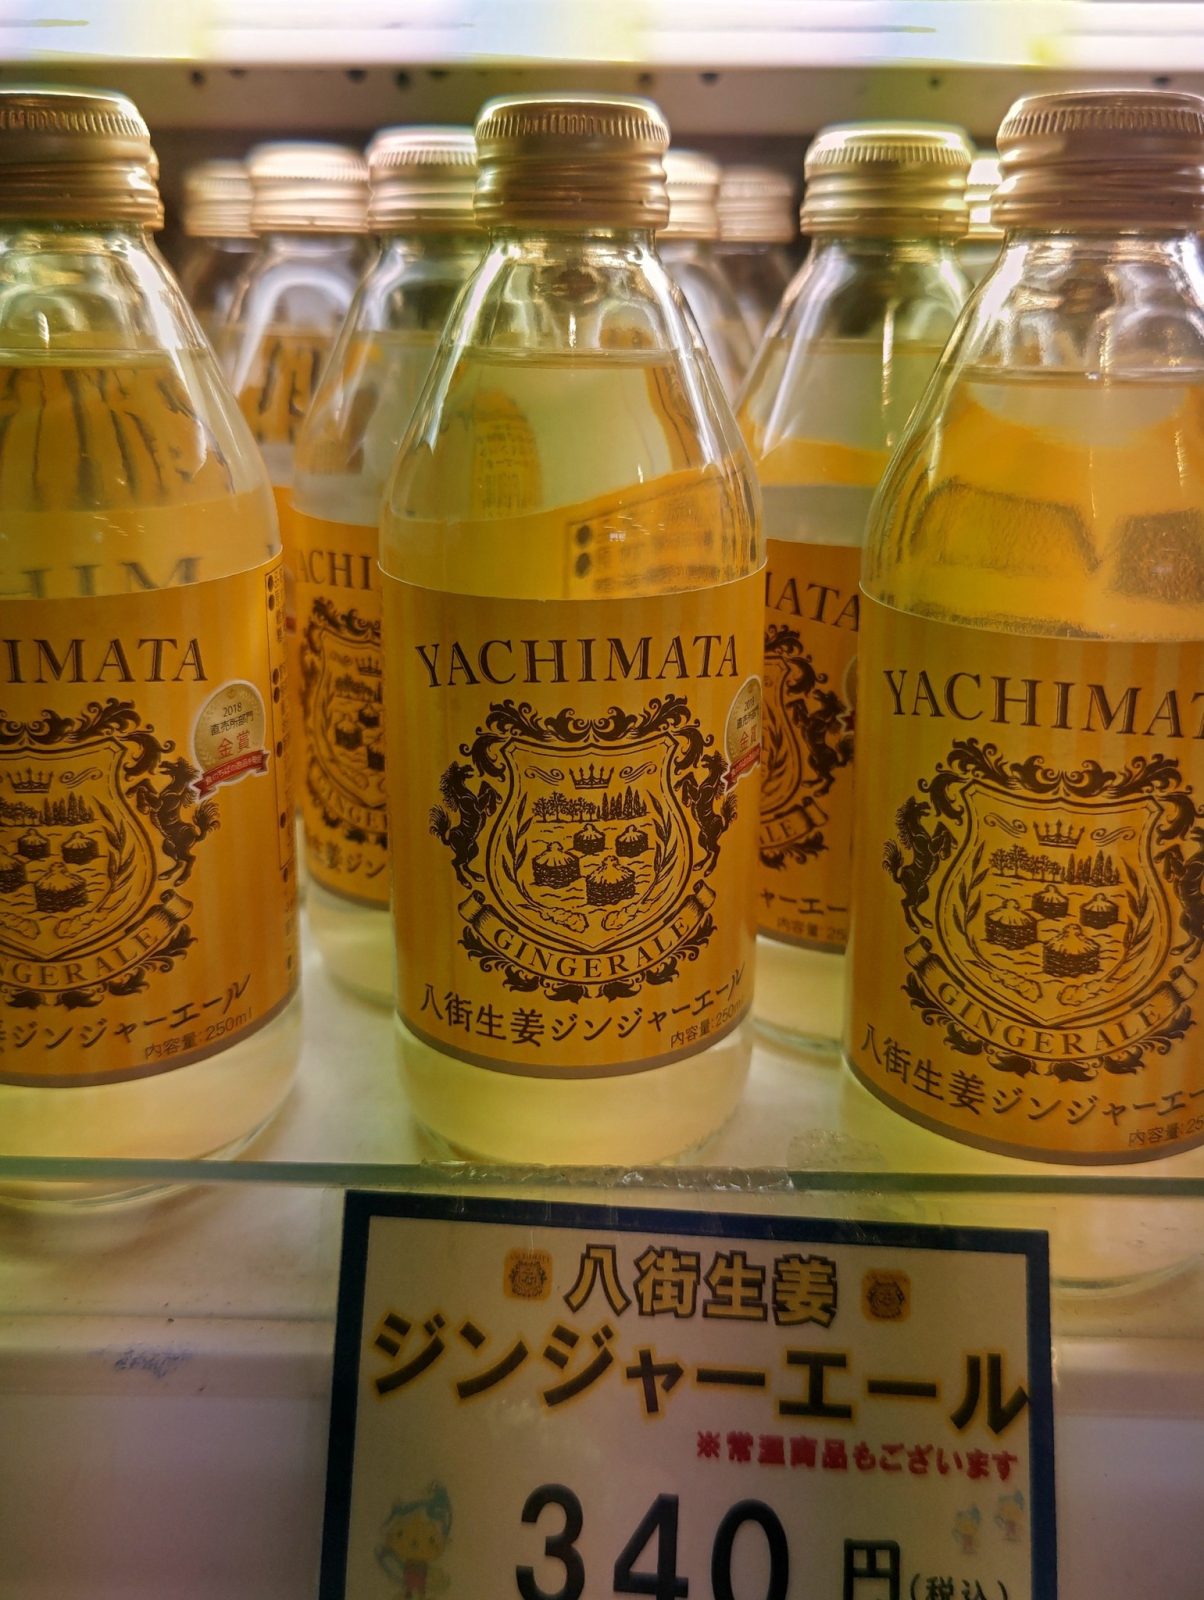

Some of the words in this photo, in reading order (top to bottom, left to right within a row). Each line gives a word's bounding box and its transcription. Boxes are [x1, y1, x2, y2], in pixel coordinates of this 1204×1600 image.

[3, 638, 208, 683] IMATA
[415, 634, 738, 688] YACHIMATA
[223, 702, 242, 717] 2018
[217, 730, 250, 759] 金賞
[0, 926, 158, 985] GERALE
[0, 974, 251, 1049] ジンジャーエール
[420, 961, 745, 1047] 八街生姜ジンジャーエール
[563, 1243, 837, 1328] 八街生姜
[374, 1311, 1031, 1434] ジンジャーエール
[514, 1483, 789, 1600] 340
